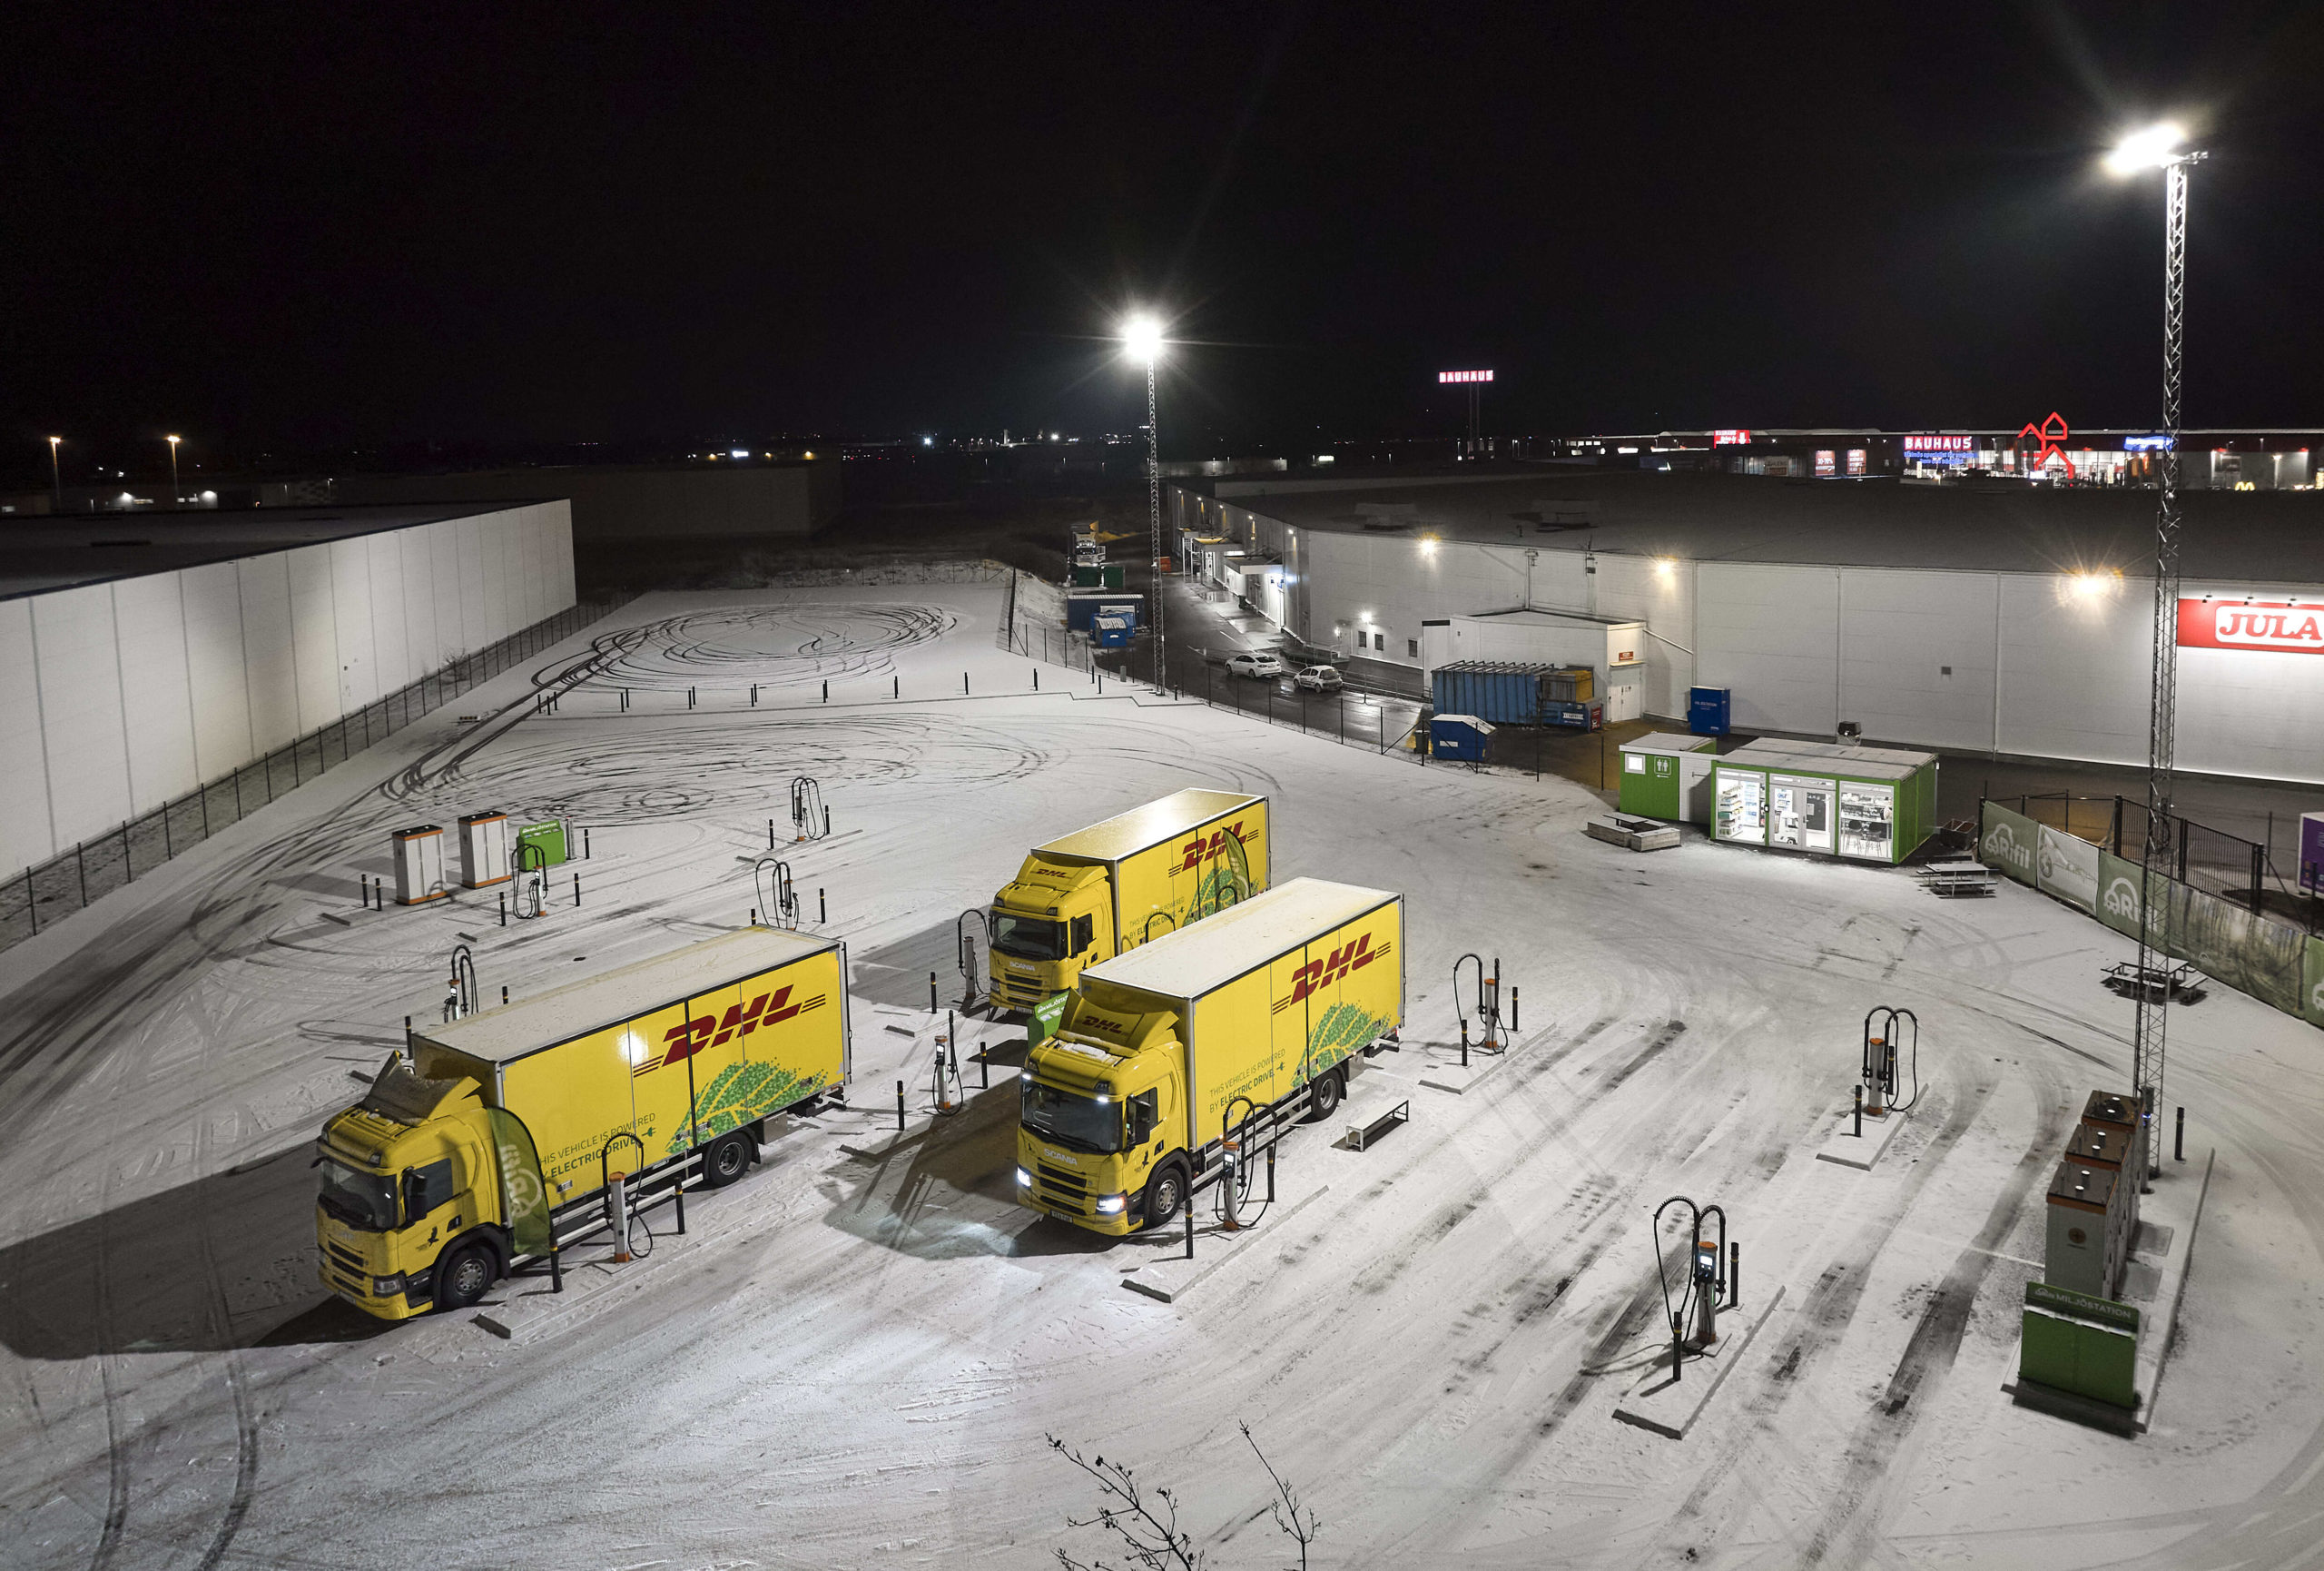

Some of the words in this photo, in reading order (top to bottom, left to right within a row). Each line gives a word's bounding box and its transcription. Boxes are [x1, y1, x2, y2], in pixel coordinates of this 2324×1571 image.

[1439, 370, 1493, 382] BAUHAUS
[1905, 436, 1972, 450] BAUHAUS
[2219, 613, 2323, 640] JULA
[1182, 821, 1248, 872] DHL
[1999, 836, 2031, 869] Rifil
[1037, 868, 1068, 878] DHL
[1009, 962, 1035, 971] SCANIA
[1290, 932, 1376, 1005] DHL
[662, 983, 803, 1067] DHL
[1082, 1015, 1123, 1034] DHL
[1209, 1082, 1225, 1098] THIS
[1225, 1068, 1250, 1089] VEHICLE
[1251, 1064, 1256, 1074] IS
[1256, 1048, 1285, 1072] POWERED
[1209, 1100, 1219, 1113] BY
[1220, 1081, 1252, 1107] ELECTRIC
[539, 1152, 556, 1165] HIS
[557, 1135, 598, 1158] VEHICLE
[600, 1131, 609, 1142] IS
[610, 1112, 655, 1138] POWERED
[550, 1148, 604, 1179] ELECTRIC
[1044, 1148, 1078, 1166] SCANIA
[2056, 1293, 2131, 1319] MILJÖSTATION
